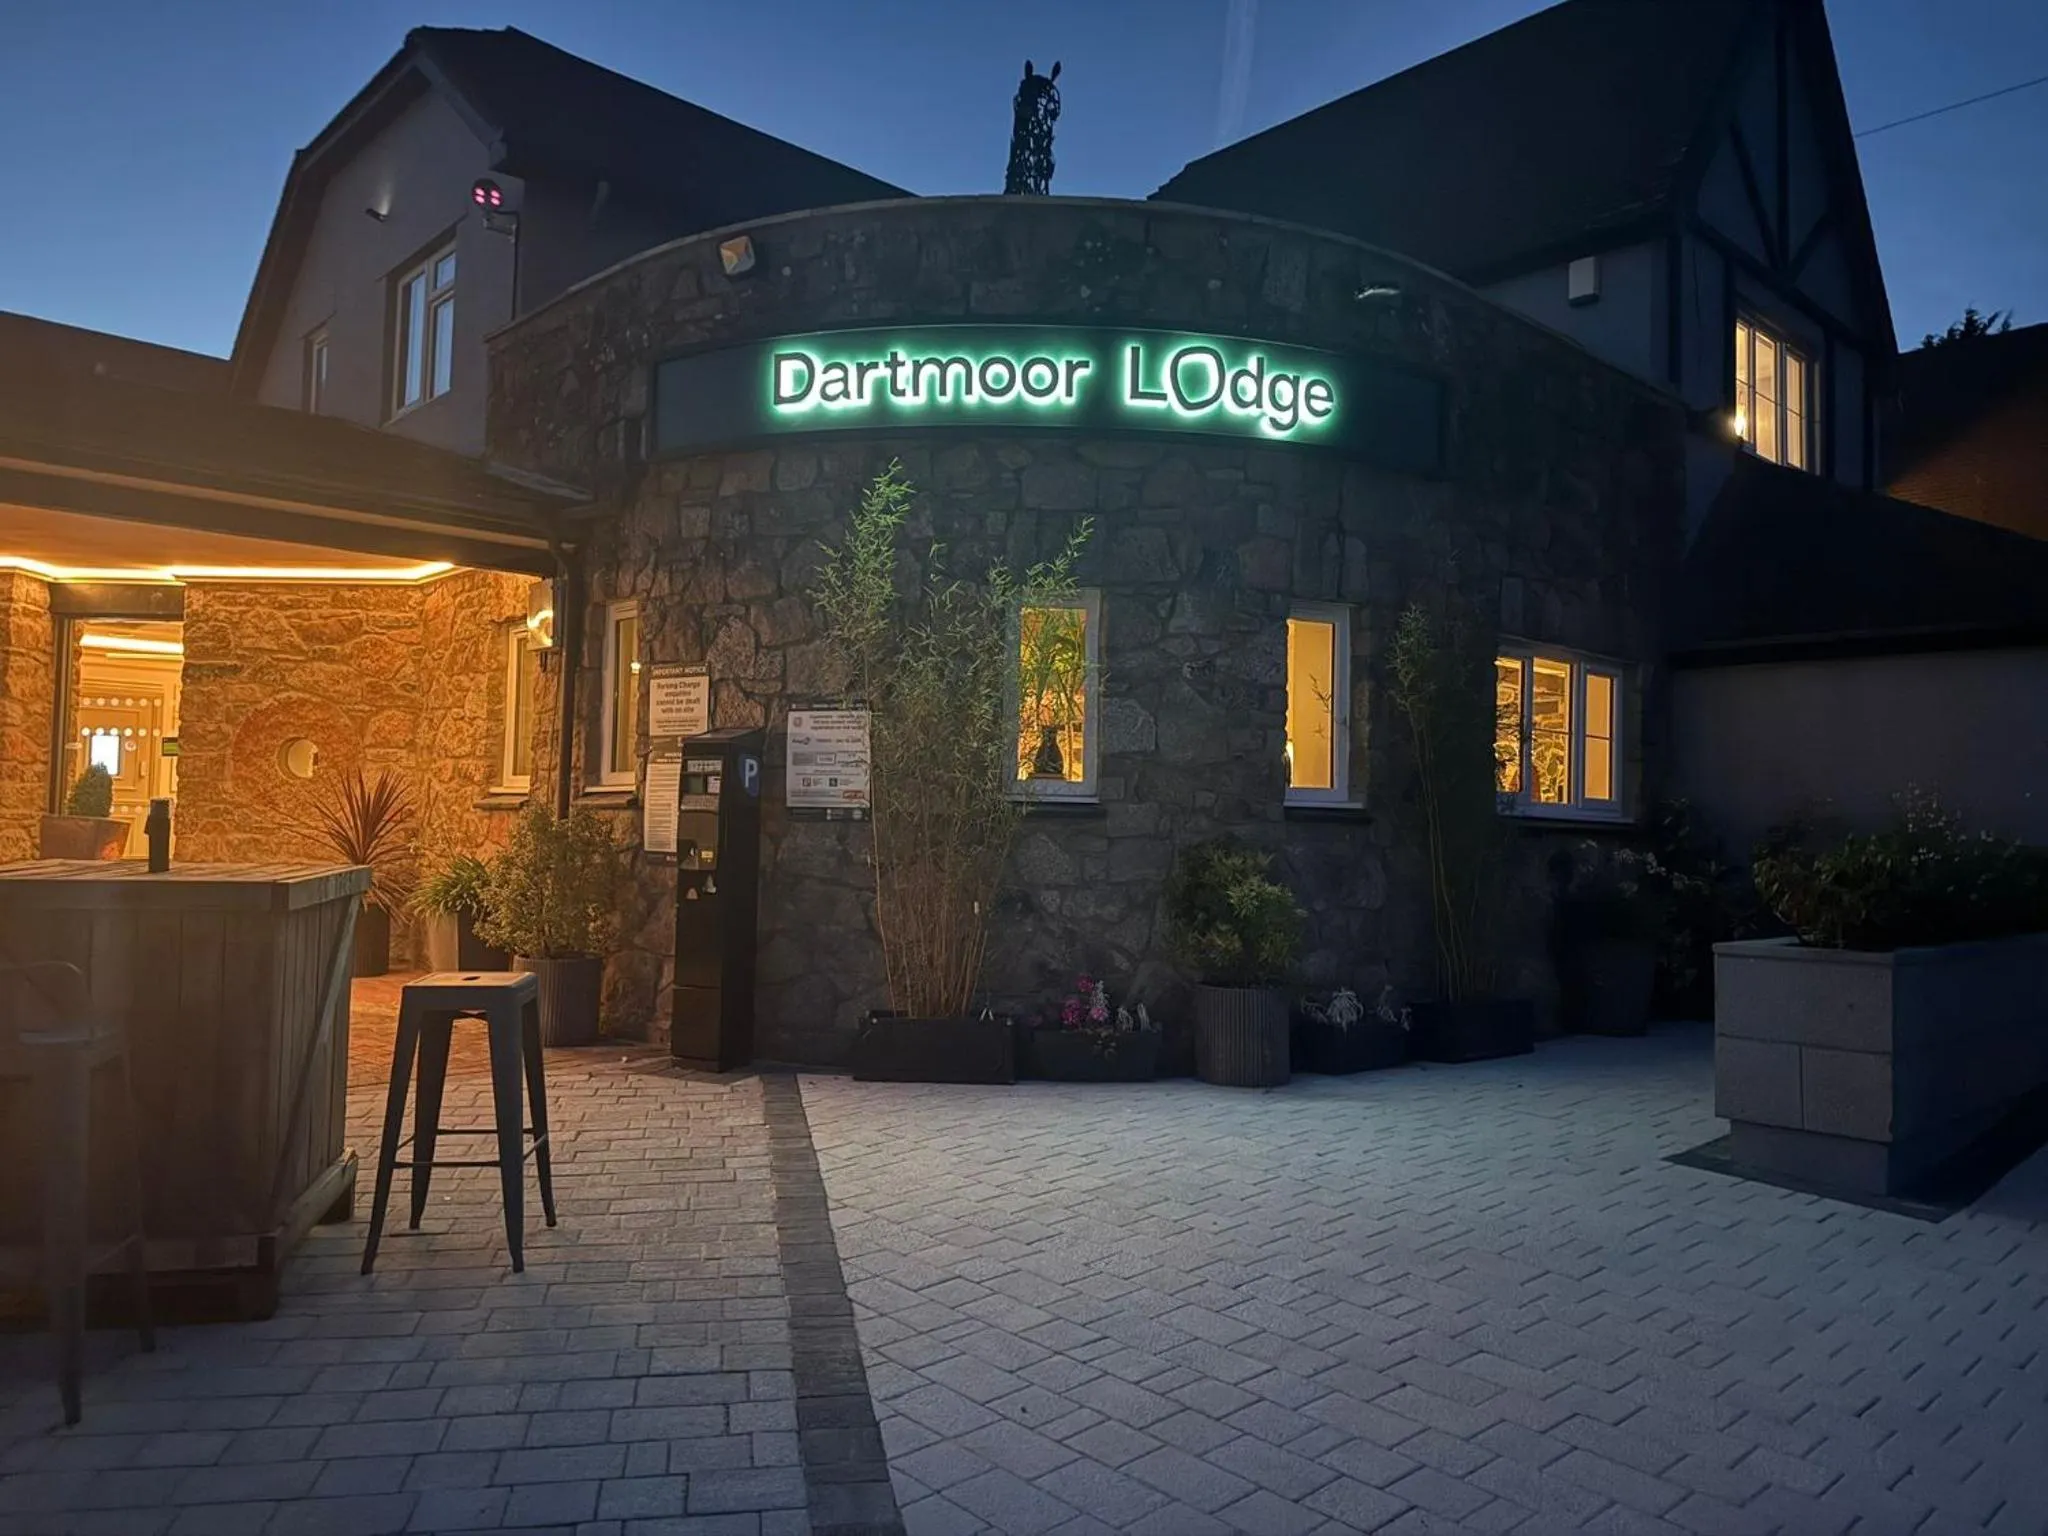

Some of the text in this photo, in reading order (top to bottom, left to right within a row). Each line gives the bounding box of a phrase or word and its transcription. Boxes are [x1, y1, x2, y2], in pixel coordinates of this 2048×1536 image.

[773, 345, 1334, 431] Dartmoor LOdge
[679, 681, 701, 689] Charge
[745, 758, 758, 788] P
